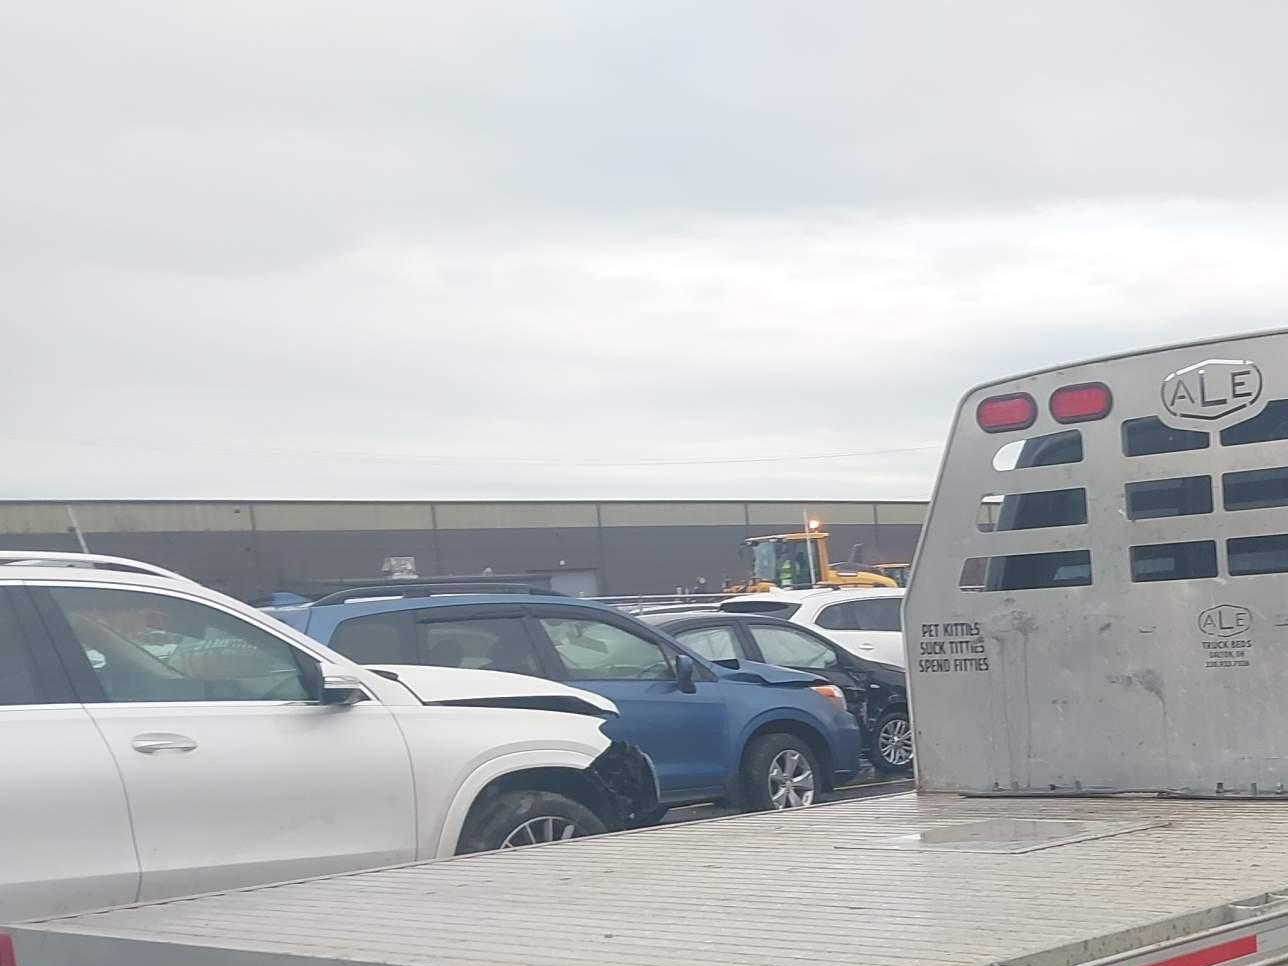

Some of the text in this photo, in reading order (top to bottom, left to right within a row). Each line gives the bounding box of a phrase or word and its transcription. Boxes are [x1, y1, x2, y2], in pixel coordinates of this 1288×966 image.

[1169, 369, 1253, 408] ALE
[1203, 610, 1247, 629] ALE
[921, 622, 981, 637] PET KITTIES
[919, 641, 946, 656] SUCK
[1201, 640, 1252, 649] TRUCK BEDS
[919, 658, 989, 672] SPEND FITTIES
